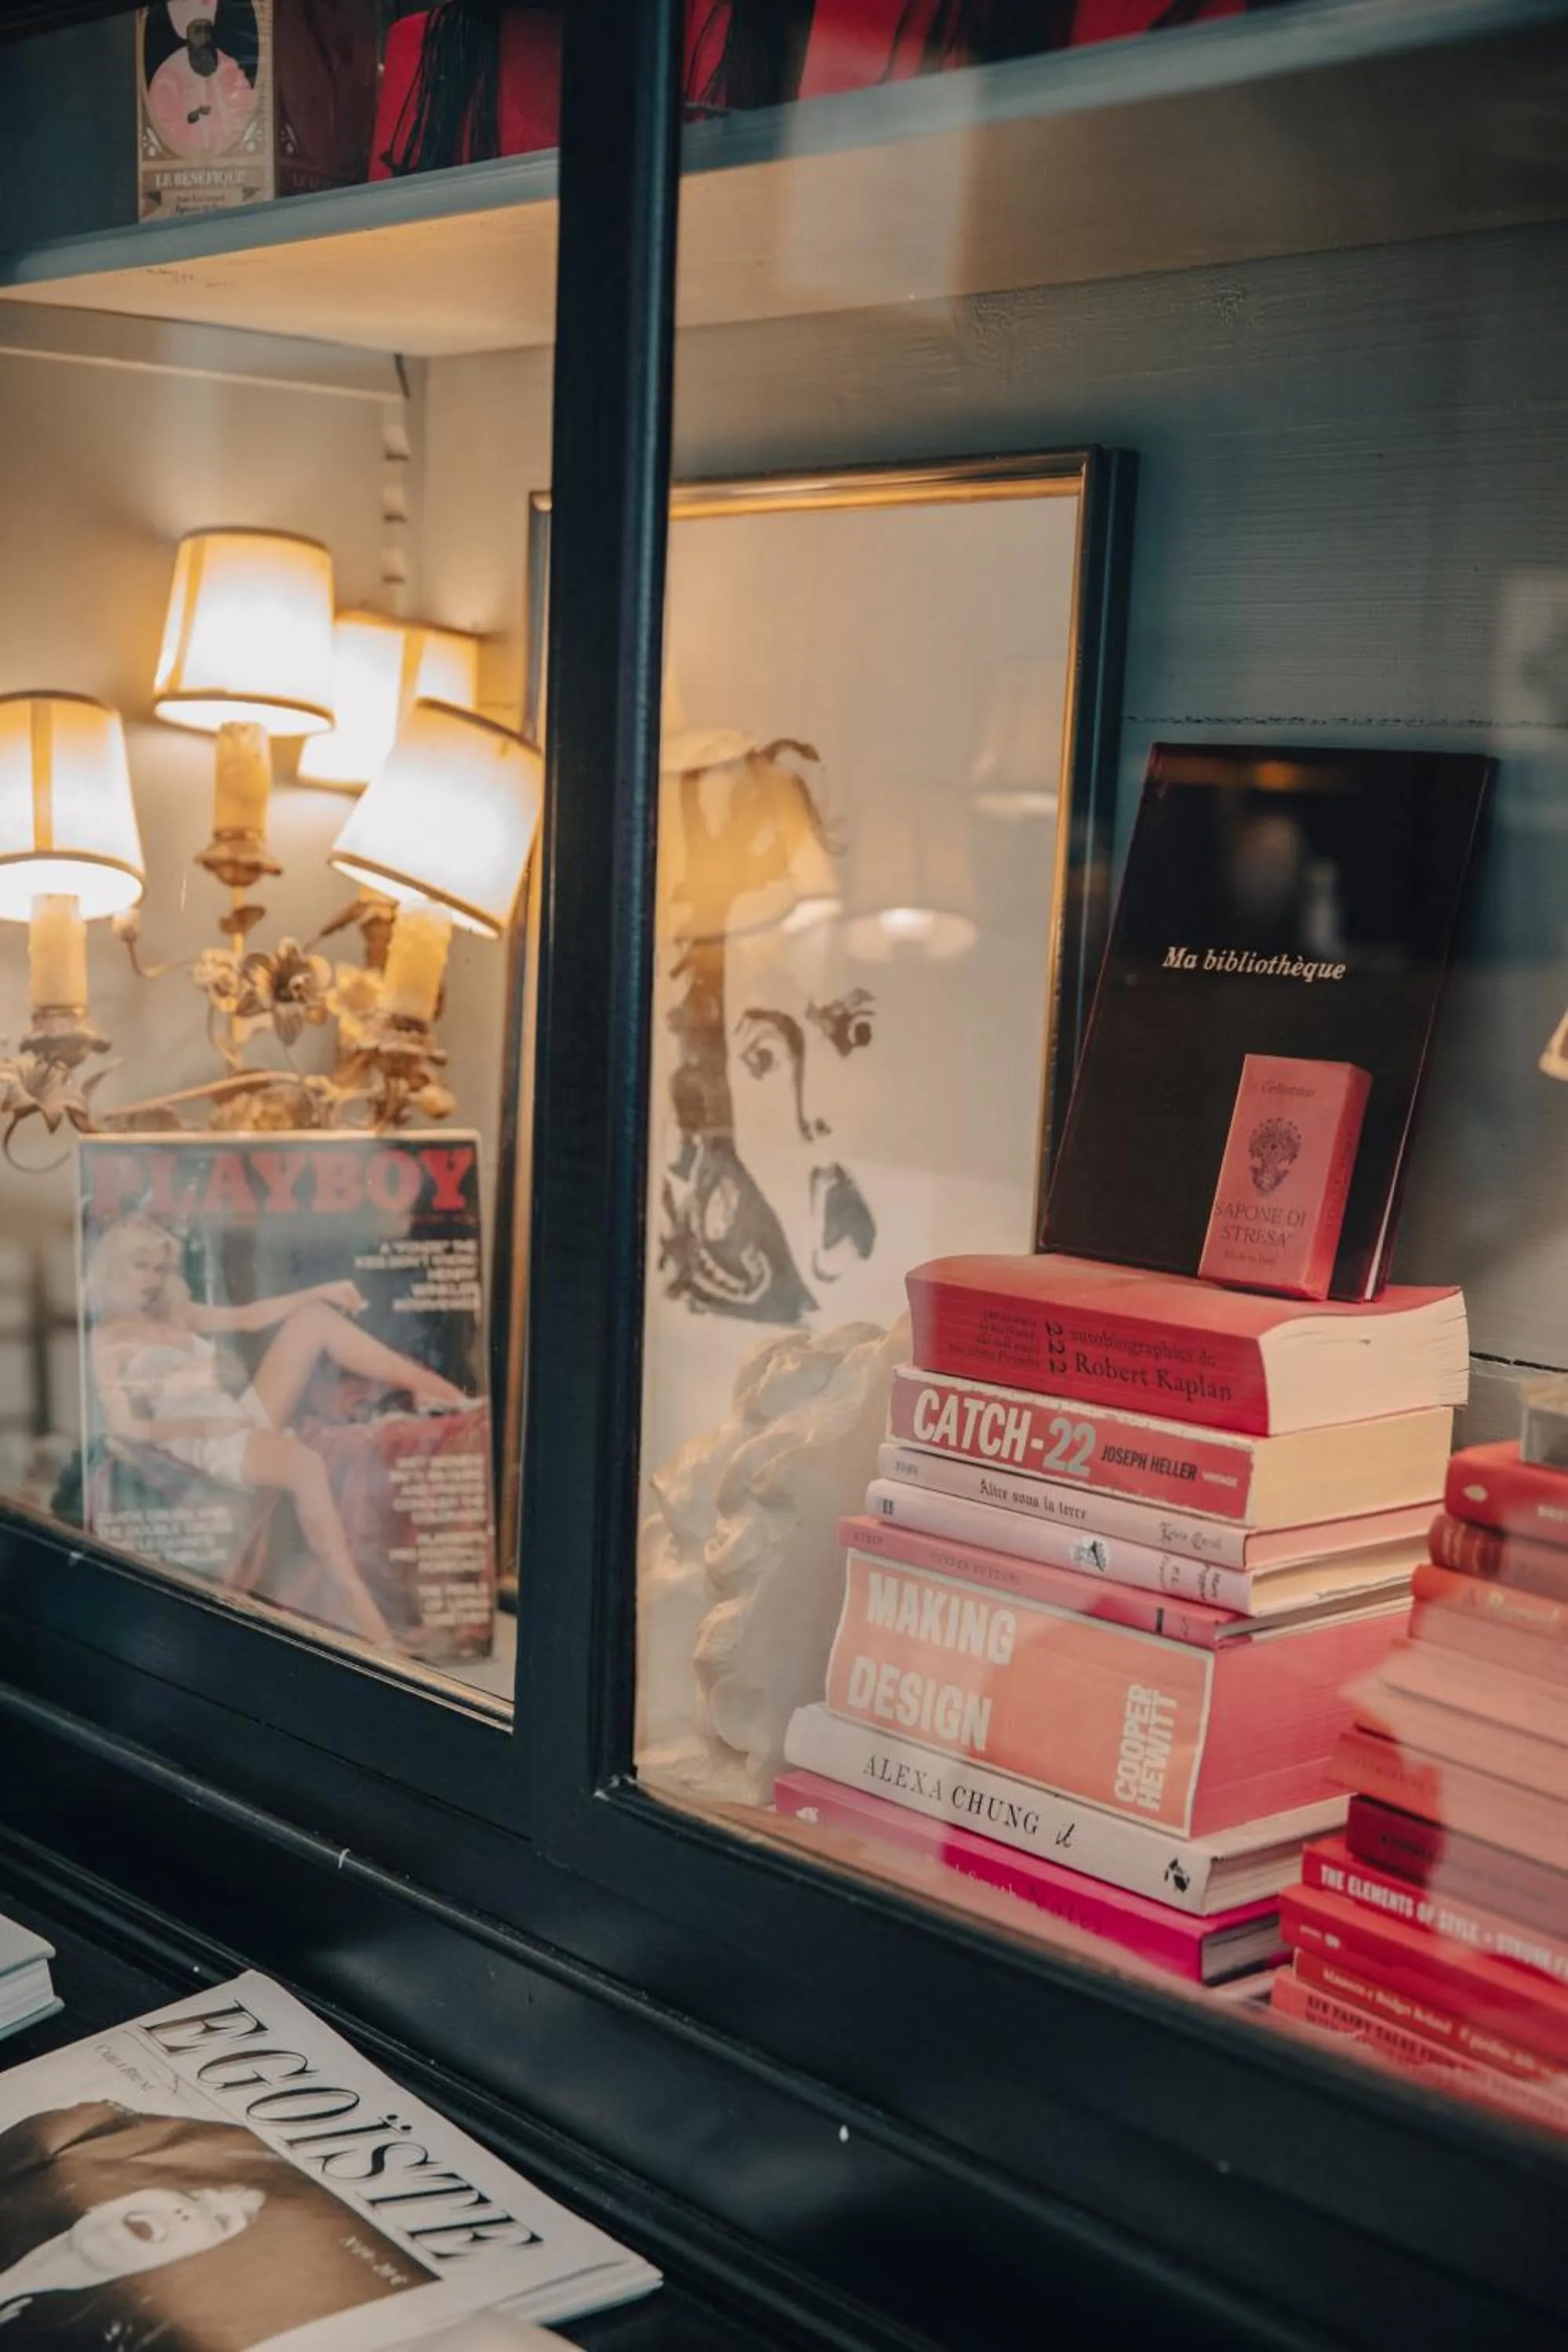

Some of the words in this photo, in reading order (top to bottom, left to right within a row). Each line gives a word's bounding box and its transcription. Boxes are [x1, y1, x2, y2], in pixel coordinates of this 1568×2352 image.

[1162, 946, 1198, 970] Ma
[1203, 948, 1347, 983] bibliothèque
[90, 1149, 475, 1220] PLAYBOY
[1214, 1203, 1284, 1225] SAPONE
[1287, 1210, 1307, 1229] DI
[1221, 1225, 1288, 1247] STRESA
[1074, 1352, 1149, 1387] Robert
[1156, 1367, 1233, 1404] Kaplan
[913, 1388, 1096, 1478] CATCH-22
[1101, 1444, 1149, 1470] JOSEPH
[1150, 1454, 1198, 1481] HELLER
[866, 1571, 1016, 1665] MAKING
[848, 1655, 993, 1751] DESIGN
[1115, 1684, 1152, 1802] COOPER
[1138, 1689, 1178, 1812] HEWITT
[862, 1755, 942, 1801] ALEXA
[952, 1784, 1040, 1835] CHUNG
[1321, 1864, 1345, 1891] THE
[1348, 1875, 1414, 1918] ELEMENTS
[1417, 1901, 1436, 1925] OF
